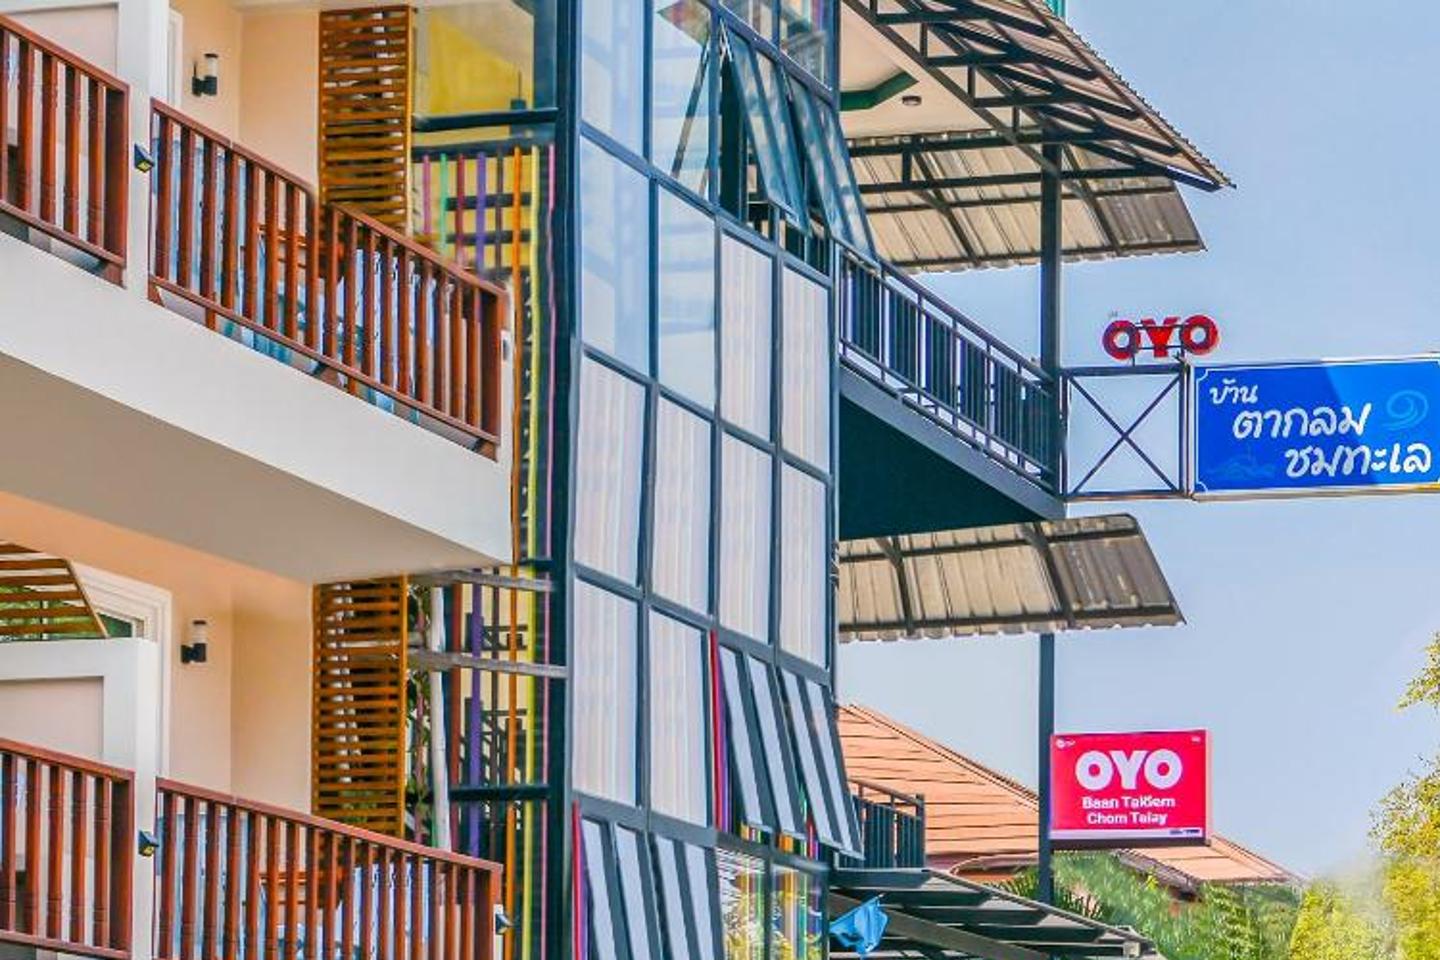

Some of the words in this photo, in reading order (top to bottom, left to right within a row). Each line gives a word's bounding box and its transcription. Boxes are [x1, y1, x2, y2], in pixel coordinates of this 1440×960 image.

[1102, 314, 1220, 360] OYO
[1209, 377, 1259, 405] บ้าน
[1232, 402, 1373, 439] ตากลม
[1284, 442, 1433, 478] ชมทะเล
[1075, 748, 1183, 791] OYO
[1087, 812, 1128, 825] Chom
[1130, 810, 1168, 825] Talay
